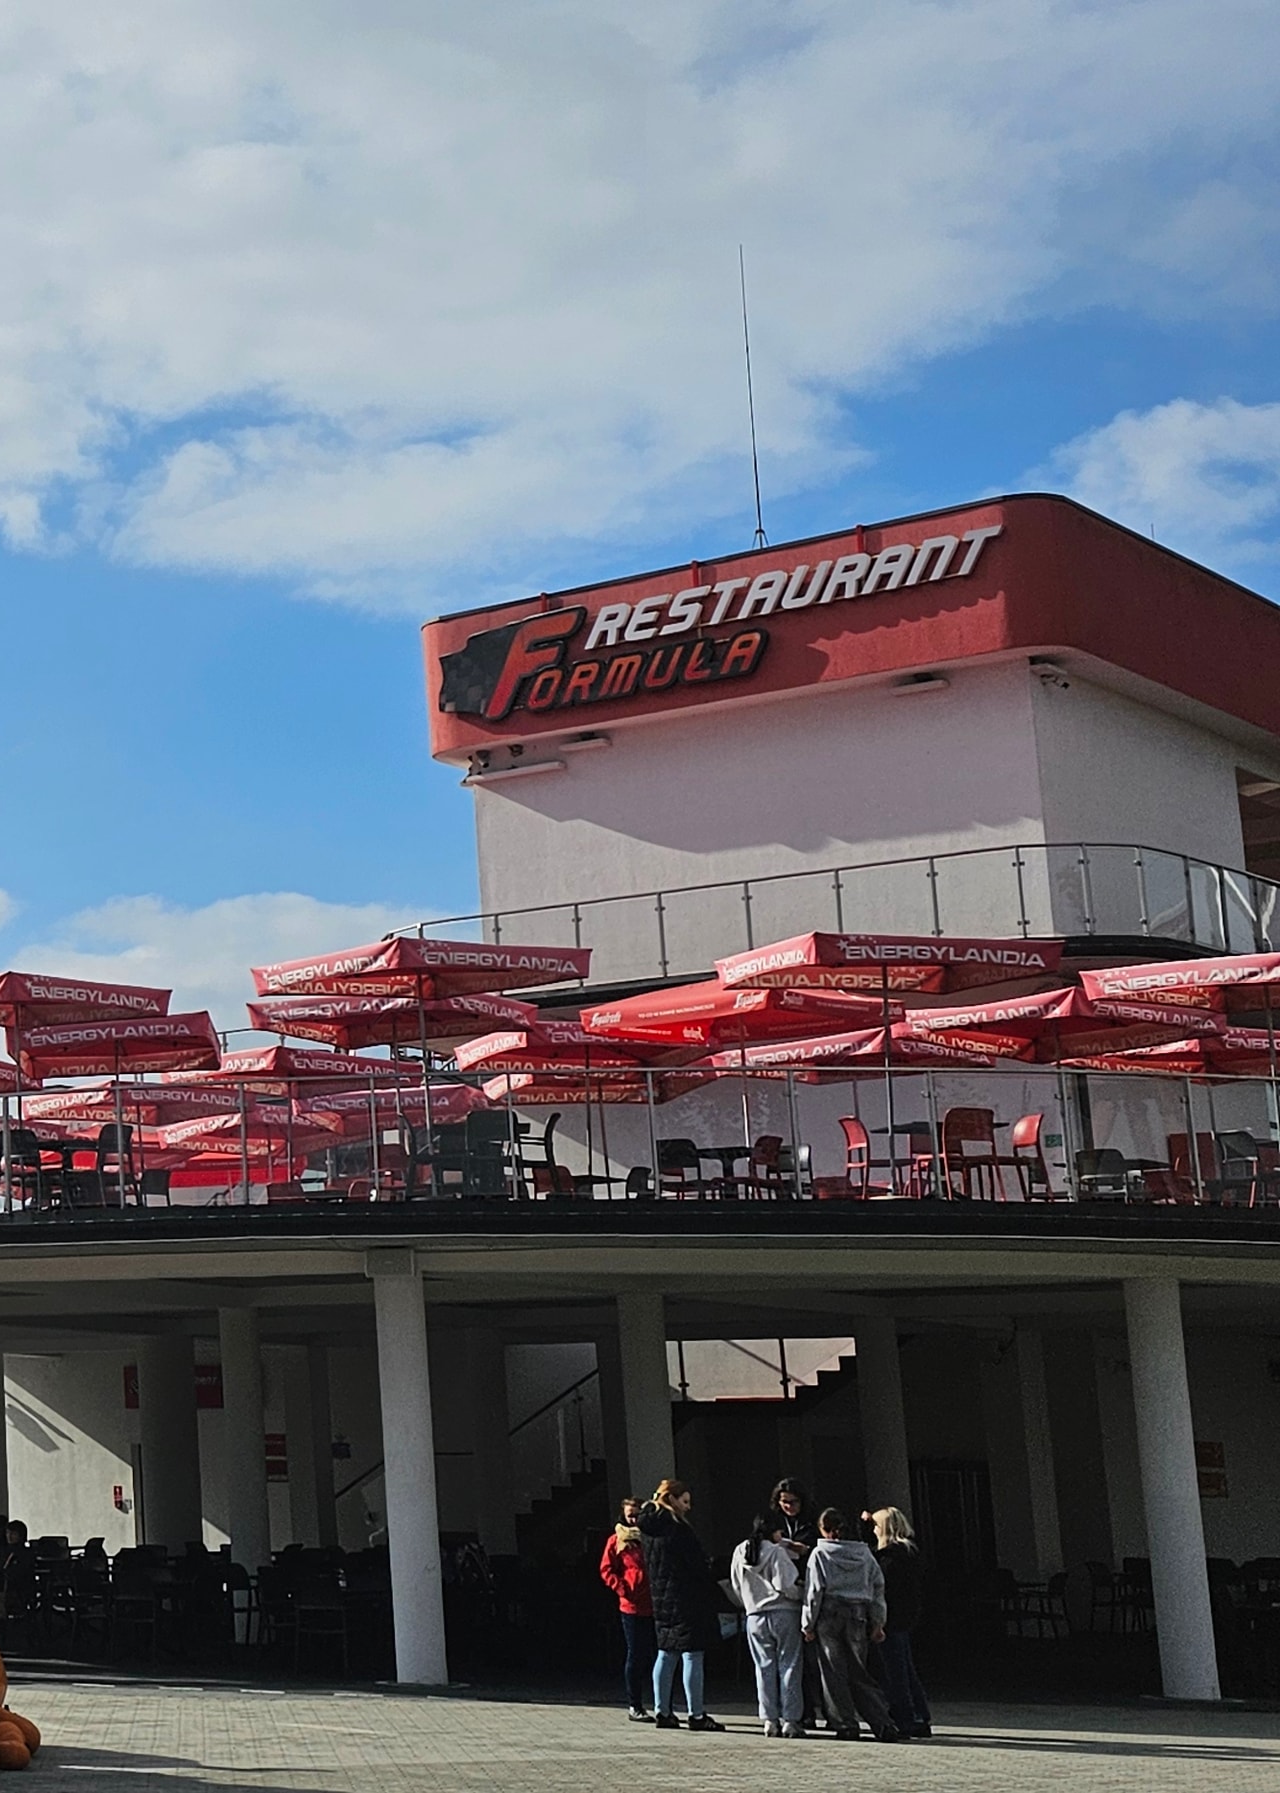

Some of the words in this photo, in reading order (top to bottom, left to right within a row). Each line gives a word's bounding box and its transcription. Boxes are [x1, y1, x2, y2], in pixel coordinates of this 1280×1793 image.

[585, 524, 1003, 650] RESTAURANT
[424, 952, 578, 973] ENERGYLANDIA
[845, 946, 1046, 967] ENERGYLANDIA
[31, 987, 160, 1011] ENERGYLANDIA
[31, 1023, 190, 1046] ENERGYLANDIA
